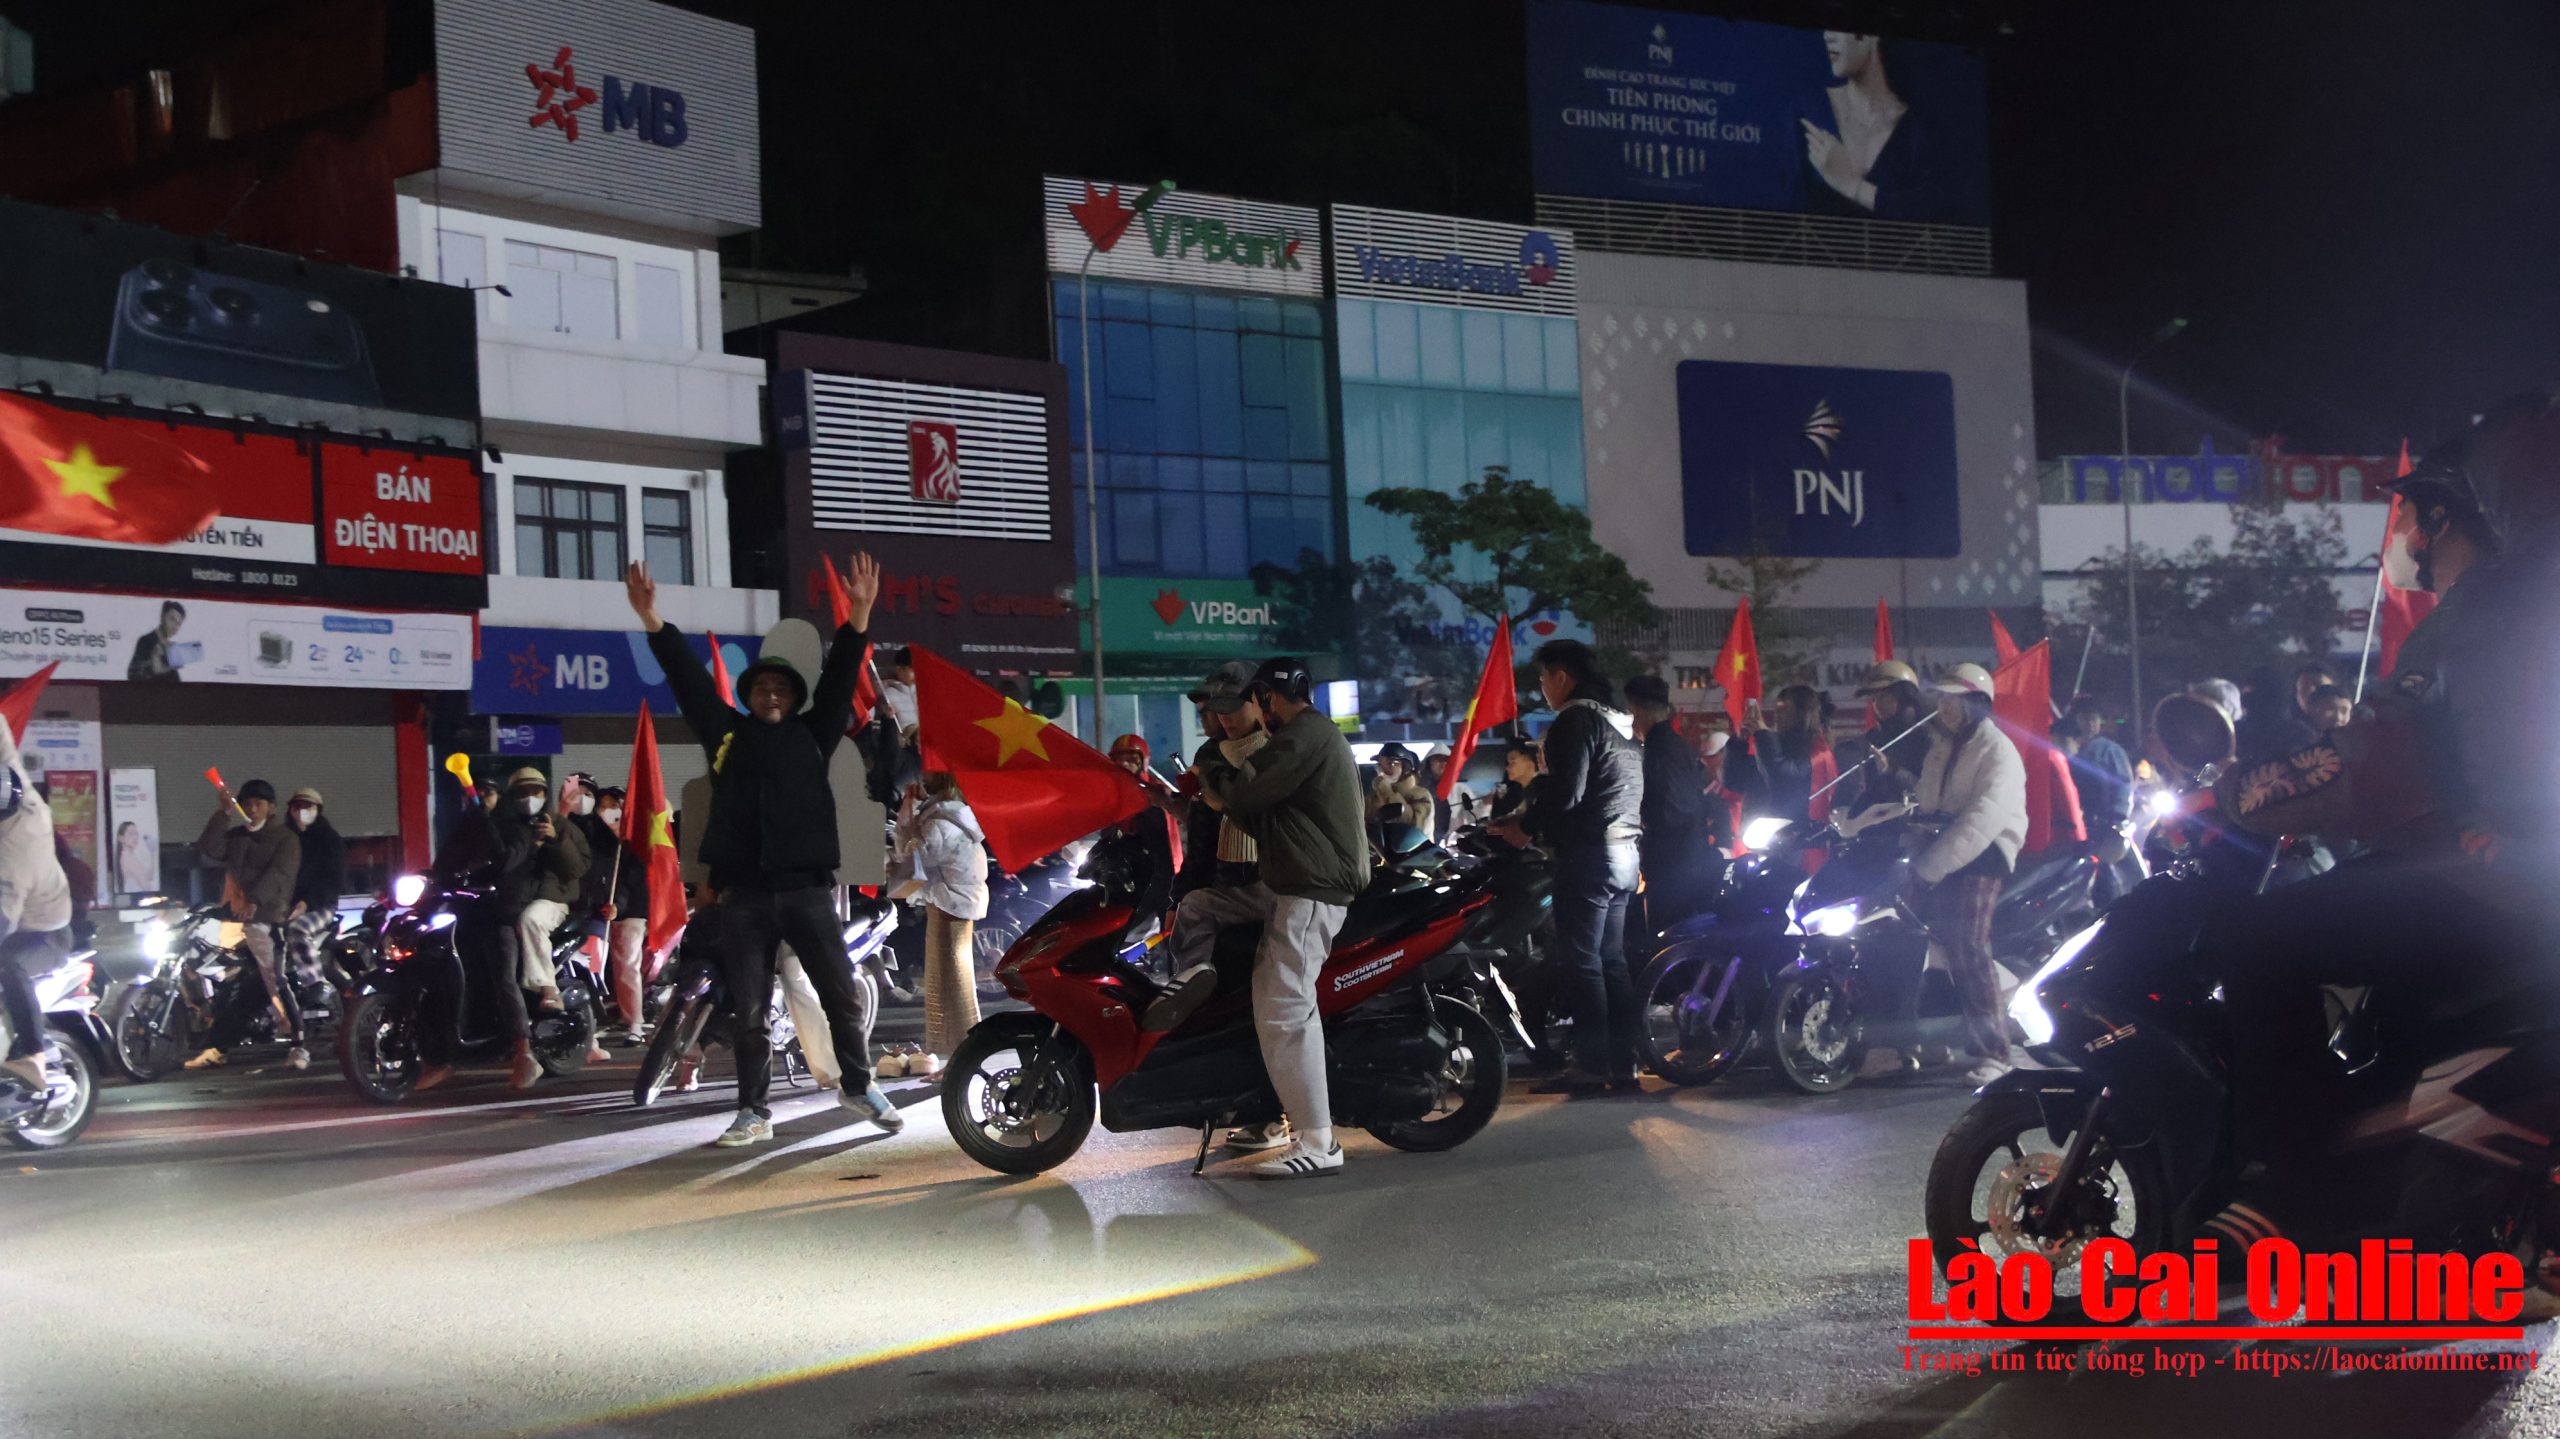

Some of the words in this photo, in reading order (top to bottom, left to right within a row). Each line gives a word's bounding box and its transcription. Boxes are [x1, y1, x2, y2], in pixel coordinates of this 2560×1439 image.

[1648, 43, 1673, 64] PNJ
[602, 74, 689, 149] MB
[1607, 86, 1648, 107] TIÊN
[1652, 93, 1718, 116] PHONG
[1561, 108, 1626, 129] CHINH
[1631, 113, 1680, 137] PHỤC
[1684, 117, 1718, 140] THẾ
[1142, 210, 1303, 272] VPBank
[376, 466, 431, 504] BÁN
[1793, 469, 1865, 528] PNJ
[336, 513, 398, 555] ĐIỆN
[402, 523, 479, 560] THOẠI
[54, 628, 107, 648] Series
[309, 643, 320, 662] 2
[345, 645, 364, 664] 24
[555, 654, 610, 690] MB
[2083, 1023, 2137, 1053] 125
